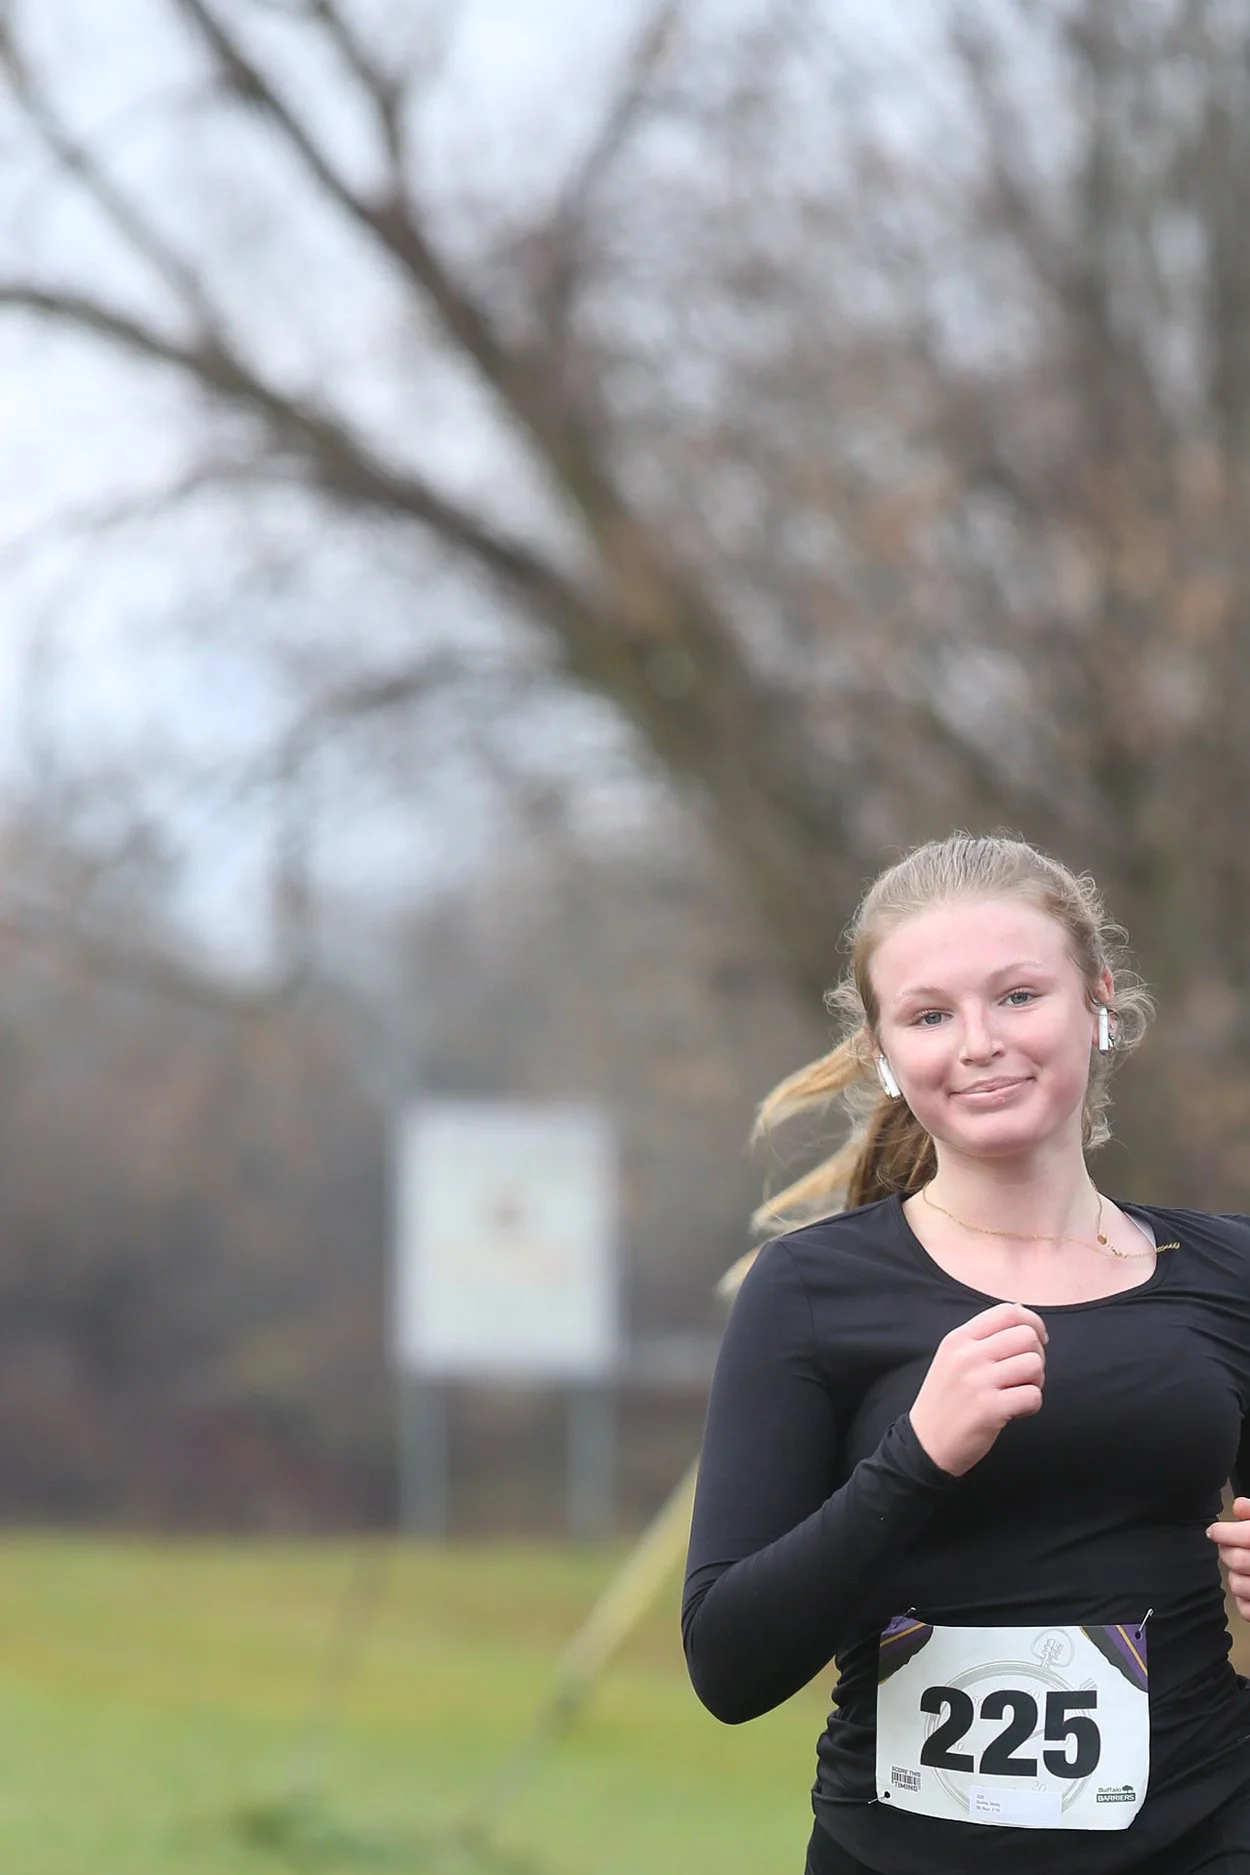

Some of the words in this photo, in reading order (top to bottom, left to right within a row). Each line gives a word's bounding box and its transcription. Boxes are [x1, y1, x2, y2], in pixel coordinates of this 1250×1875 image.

[919, 1685, 1101, 1779] 225
[892, 1765, 908, 1773] SCORE
[895, 1779, 918, 1791] TIMING
[1097, 1794, 1135, 1802] BARRIERS
